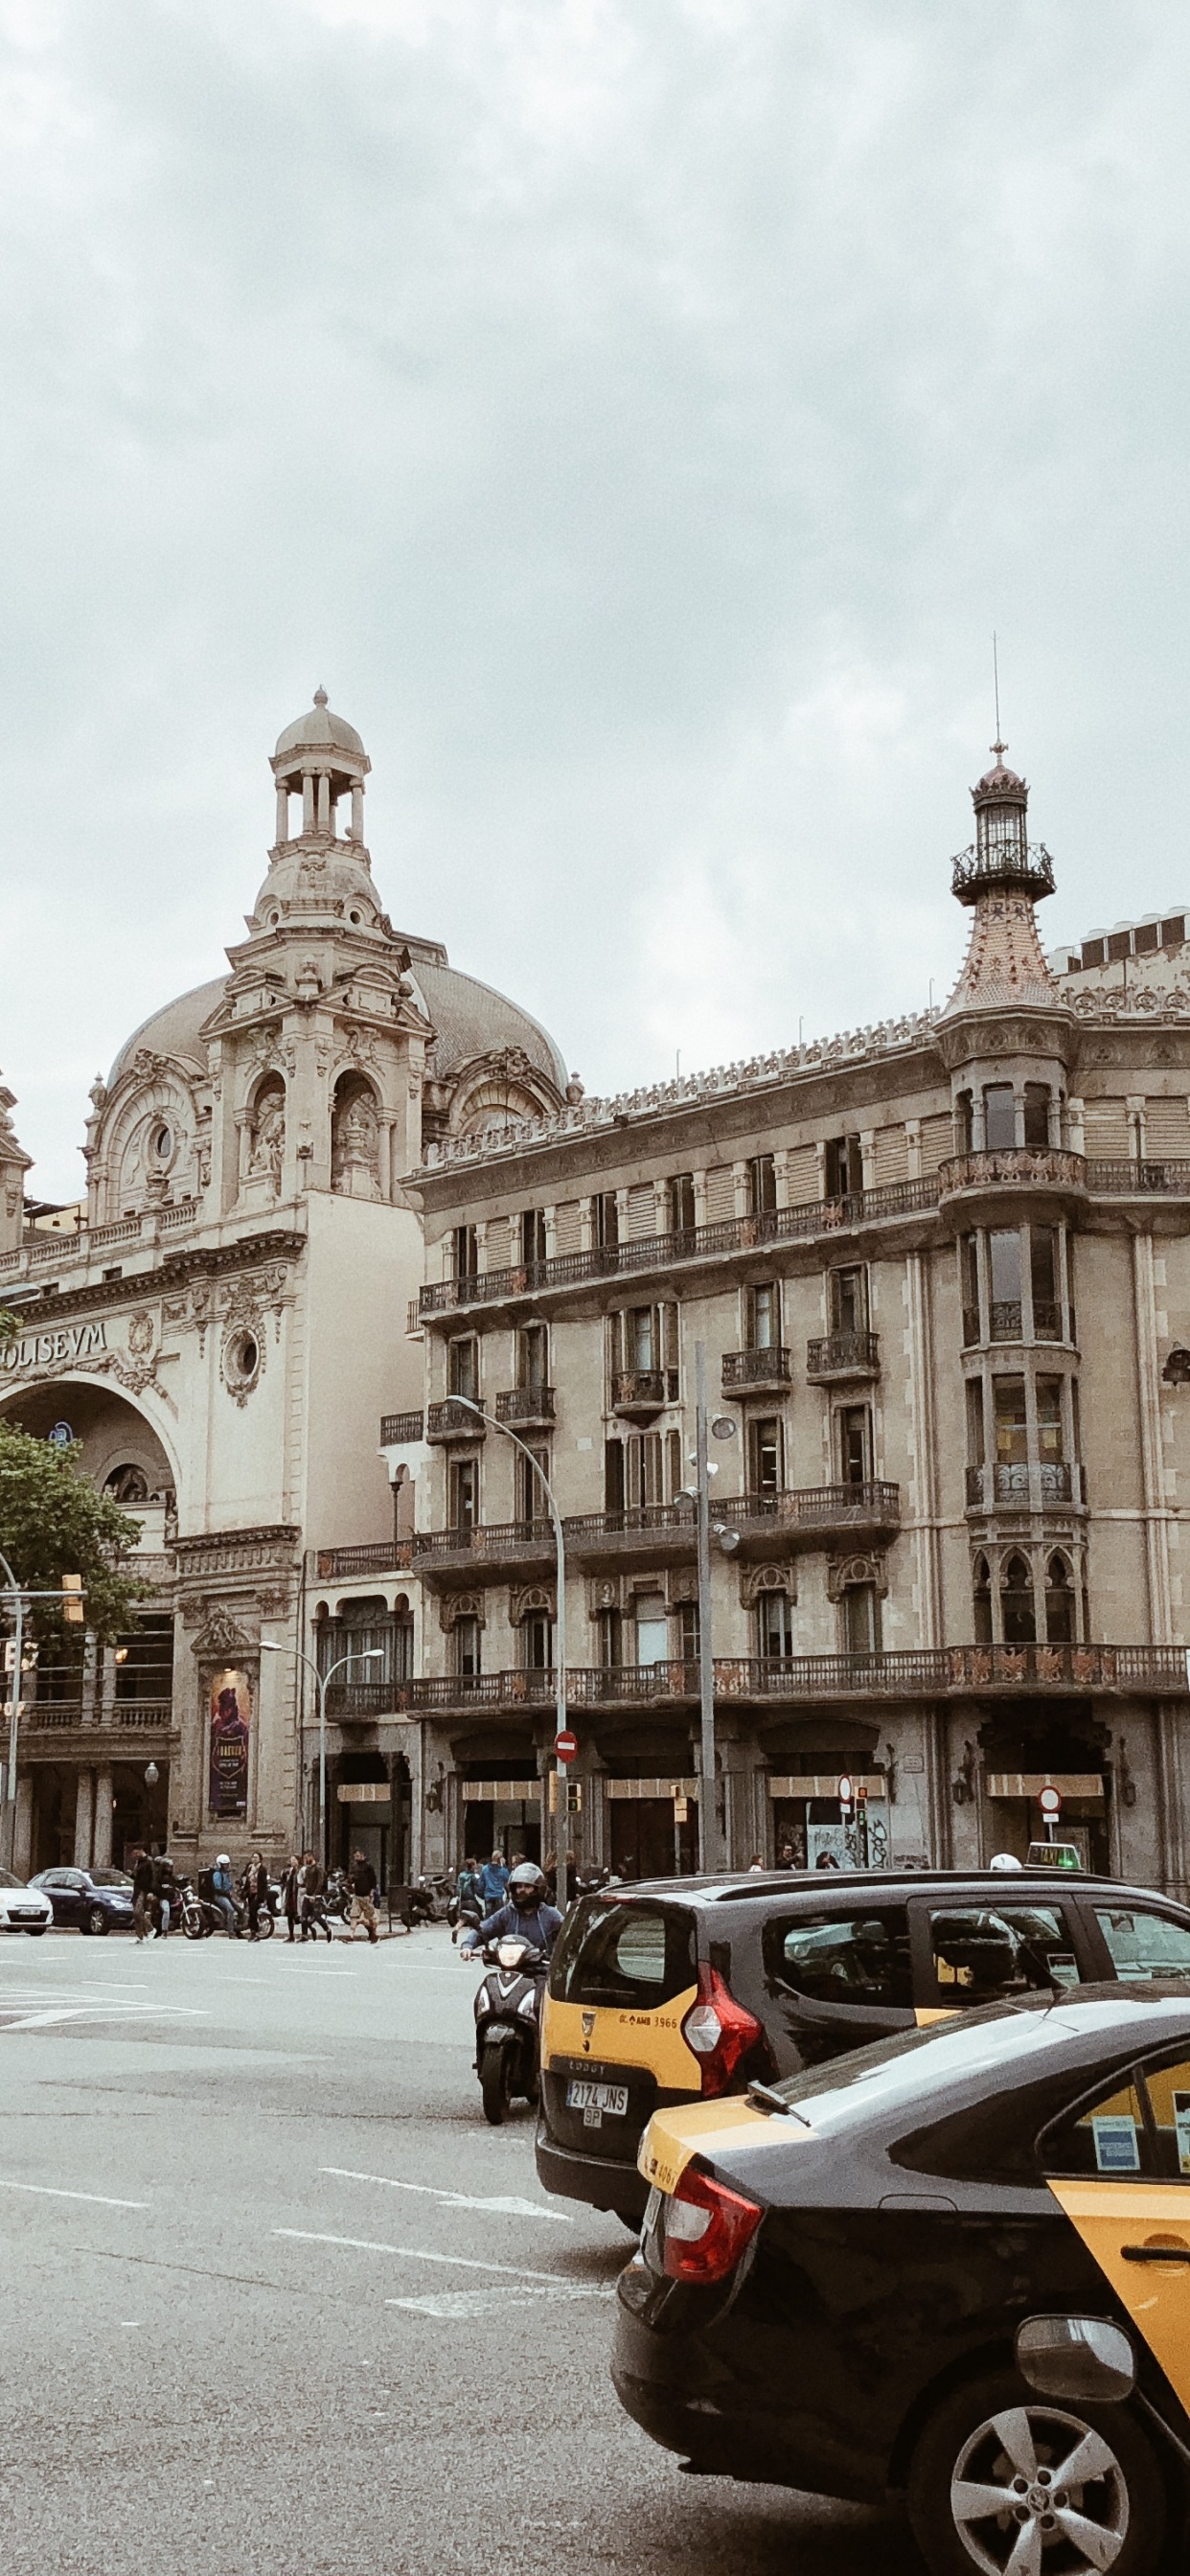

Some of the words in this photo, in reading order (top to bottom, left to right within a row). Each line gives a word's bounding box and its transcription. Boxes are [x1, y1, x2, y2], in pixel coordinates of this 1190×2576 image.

[0, 1322, 107, 1368] OLISEVM
[654, 2016, 677, 2029] 3966
[569, 2060, 606, 2075] LODGY
[573, 2083, 598, 2105] 2174
[603, 2088, 625, 2110] JNS
[585, 2109, 601, 2124] SP
